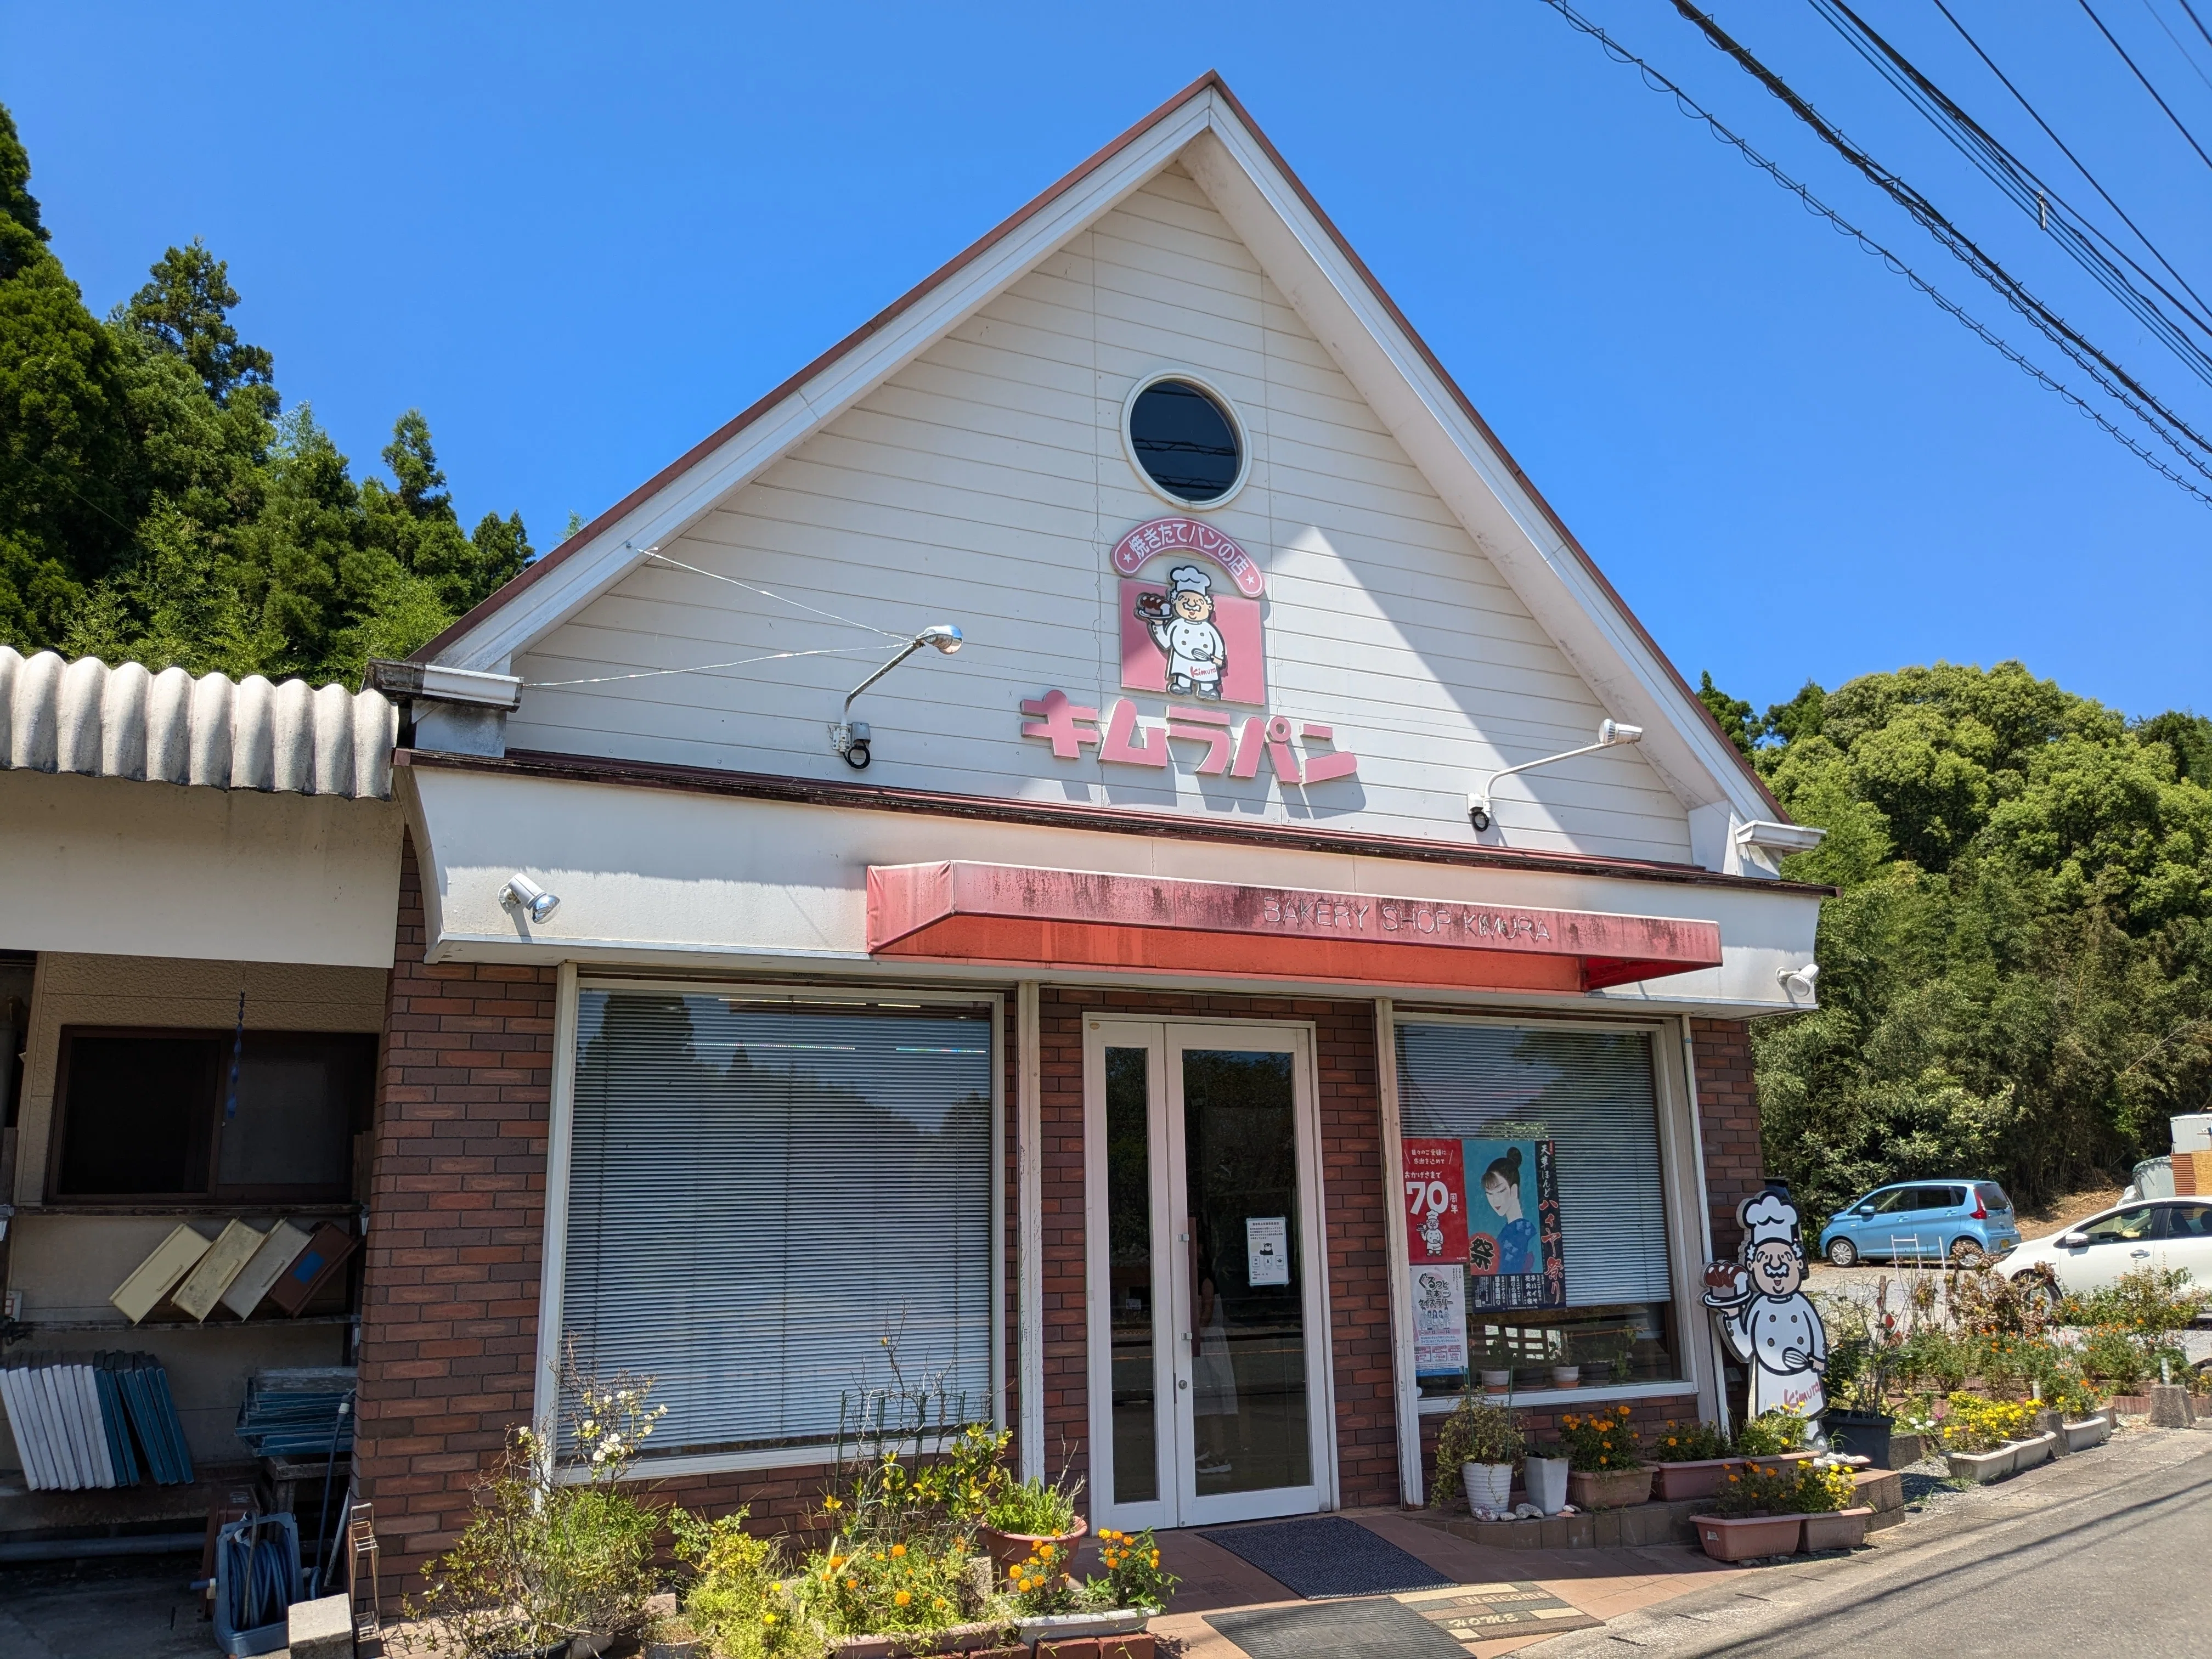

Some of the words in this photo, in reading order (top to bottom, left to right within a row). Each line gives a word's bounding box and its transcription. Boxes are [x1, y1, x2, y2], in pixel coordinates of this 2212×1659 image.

[1128, 523, 1249, 577] 焼きたてパンの店
[1190, 666, 1216, 678] Kimura
[1020, 689, 1358, 785] キムラパン
[1263, 897, 1369, 931] BAKERY
[1382, 906, 1451, 933] SHOP
[1463, 911, 1550, 943] KIMURA
[1404, 1171, 1442, 1179] おかげさまで
[1406, 1181, 1448, 1215] 70
[1450, 1193, 1458, 1214] 周年
[1418, 1273, 1448, 1289] ぐるっと
[1426, 1289, 1441, 1298] 熊本
[1784, 1381, 1820, 1410] Kimura
[1459, 1591, 1550, 1605] Welcome
[1448, 1613, 1519, 1627] HOME
